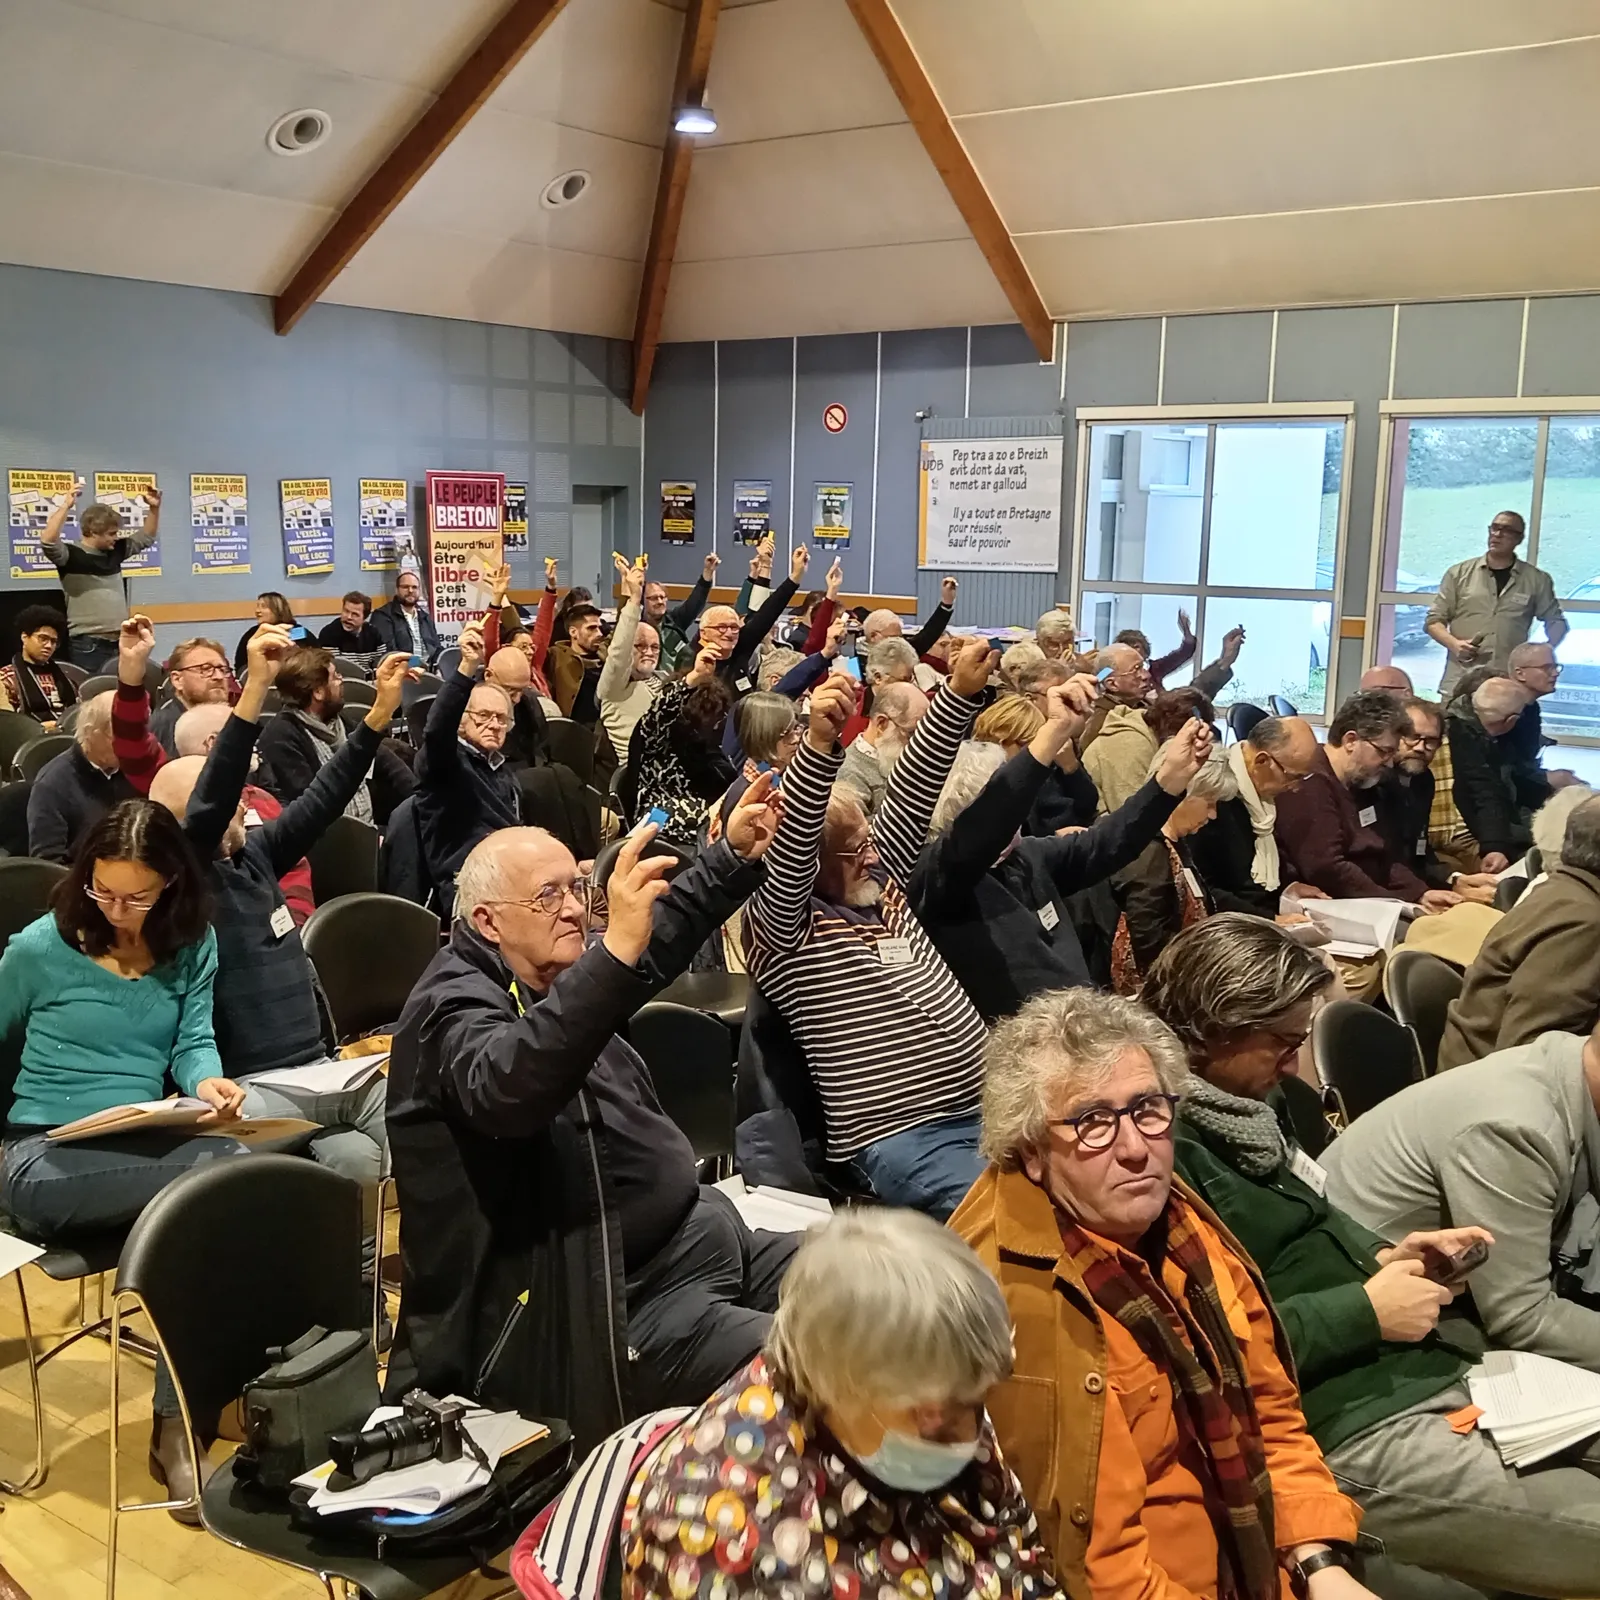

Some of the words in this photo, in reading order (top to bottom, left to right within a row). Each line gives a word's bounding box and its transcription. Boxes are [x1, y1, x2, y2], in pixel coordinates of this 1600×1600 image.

[953, 449, 969, 465] Pep
[972, 450, 987, 460] tra
[996, 451, 1007, 460] zo
[1010, 452, 1015, 460] e
[1018, 448, 1048, 460] Breizh
[922, 460, 944, 471] UDB
[950, 464, 968, 476] evit
[970, 464, 992, 475] dont
[994, 463, 1006, 475] da
[1009, 464, 1027, 476] vat,
[42, 482, 53, 490] ER
[54, 482, 71, 490] VRO
[126, 484, 136, 492] ER
[315, 488, 328, 496] VRO
[950, 479, 979, 490] nemet
[981, 481, 991, 490] ar
[993, 478, 1026, 493] galloud
[436, 482, 449, 503] LE
[453, 483, 496, 504] PEUPLE
[436, 506, 496, 527] BRETON
[953, 507, 960, 518] Il
[960, 509, 966, 521] y
[967, 510, 972, 518] a
[975, 508, 995, 519] tout
[997, 510, 1007, 519] en
[1009, 507, 1051, 522] Bretagne
[948, 524, 968, 537] pour
[970, 521, 1002, 535] réussir,
[434, 541, 494, 551] Aujourd'hui
[948, 536, 968, 548] sauf
[969, 536, 976, 548] le
[978, 537, 1011, 552] pouvoir
[434, 552, 465, 564] être
[435, 567, 479, 582] libre
[435, 584, 466, 593] c'est
[436, 596, 467, 608] être
[437, 609, 485, 622] inform
[1560, 690, 1599, 702] EY-942-L
